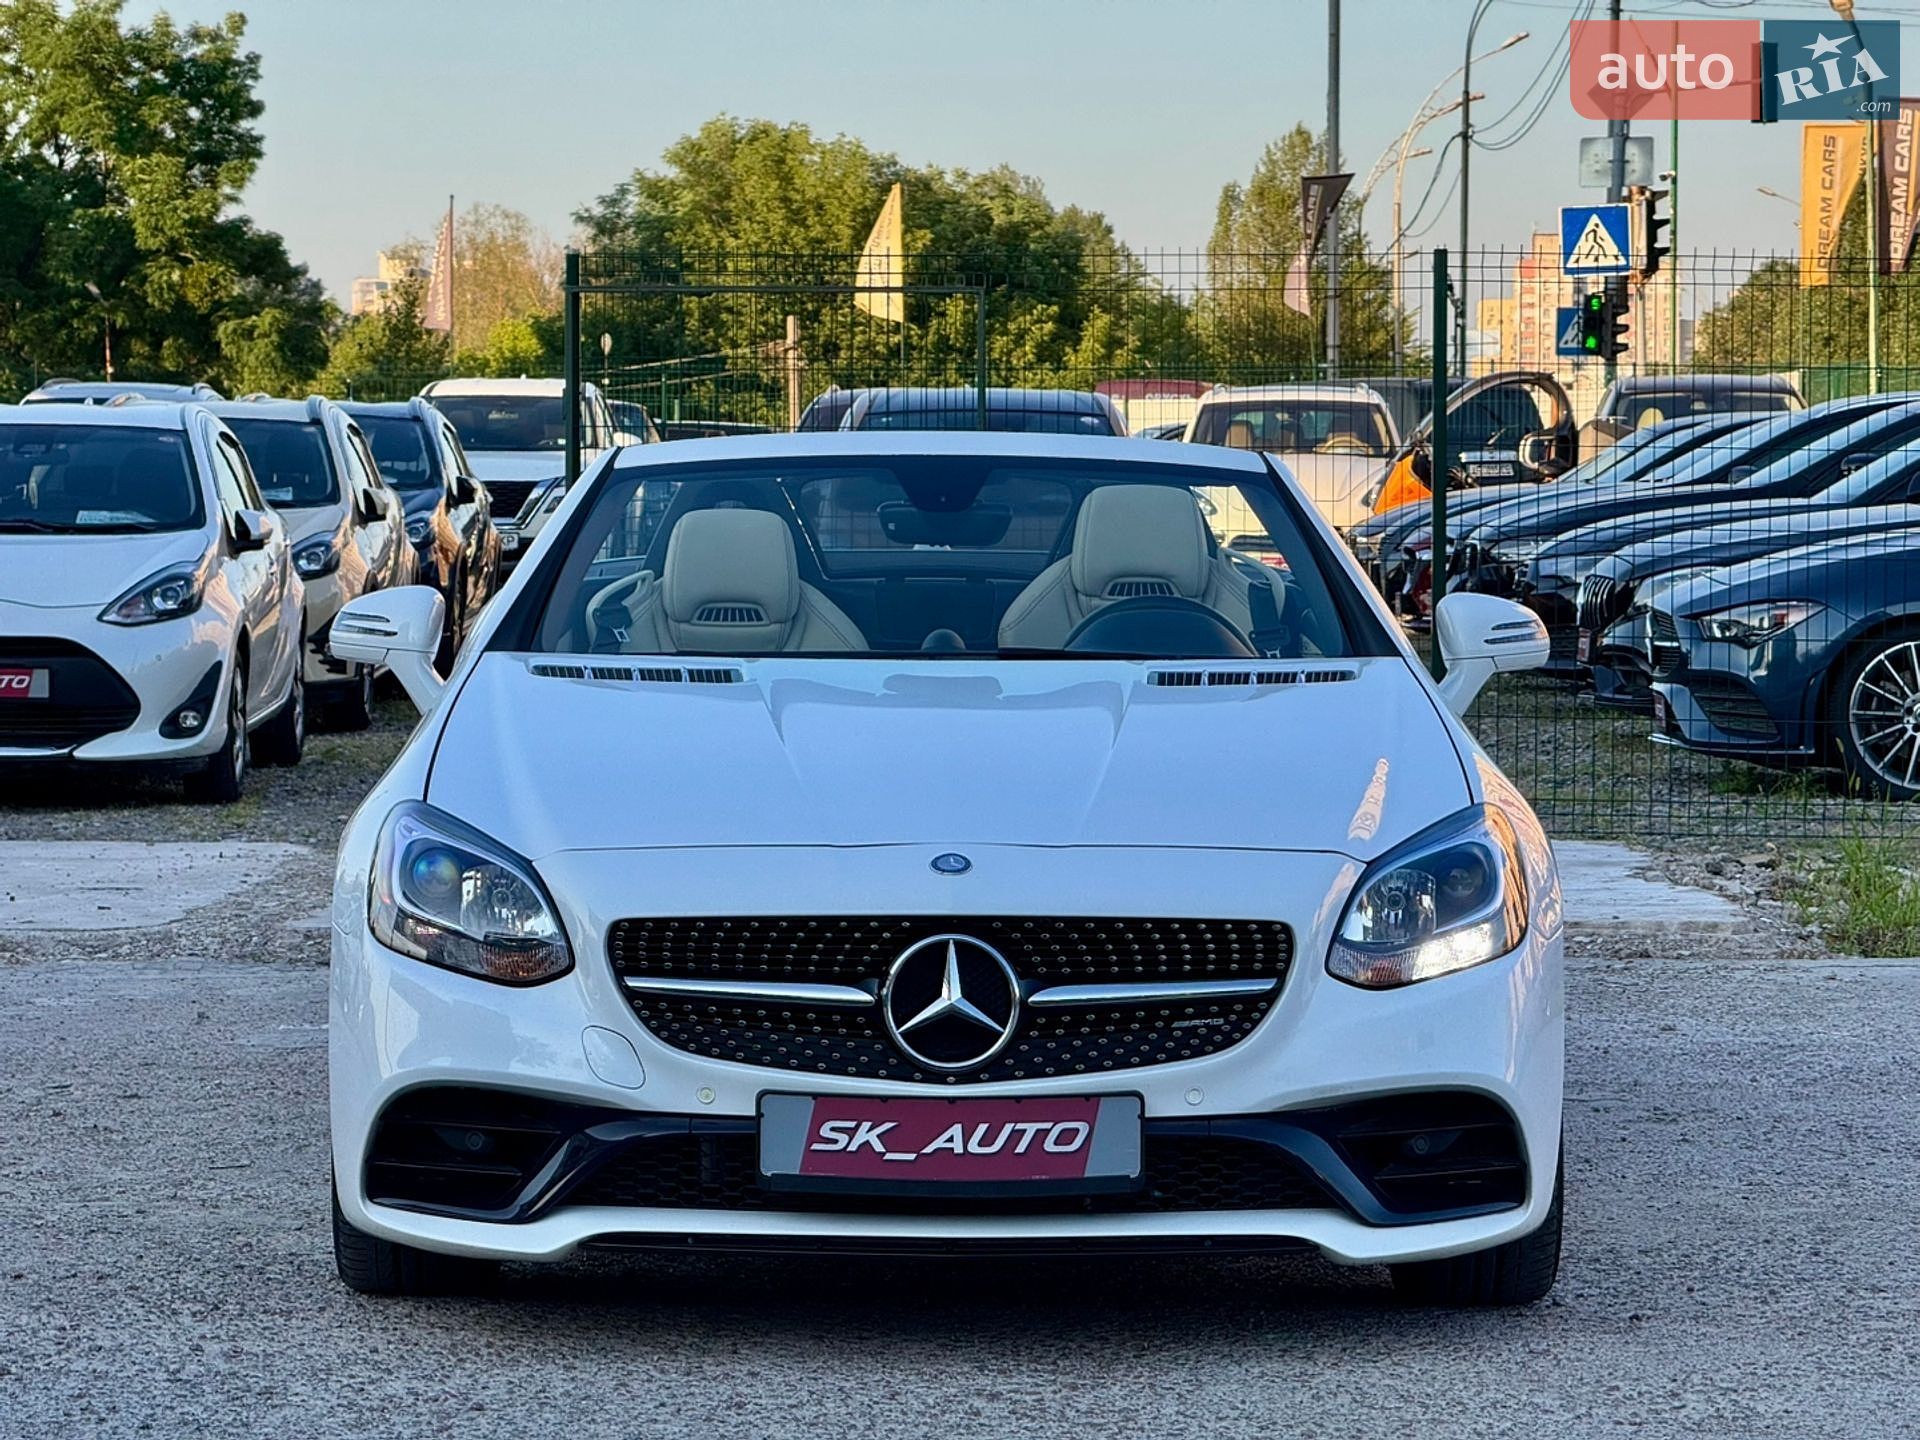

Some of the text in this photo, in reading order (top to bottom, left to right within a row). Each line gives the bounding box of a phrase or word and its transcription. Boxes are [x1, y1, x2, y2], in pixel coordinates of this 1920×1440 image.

[1894, 108, 1913, 172] CARS
[1818, 135, 1836, 269] DREAM CARS
[1889, 177, 1909, 263] DREAM
[809, 1120, 1090, 1161] SK_AUTO
